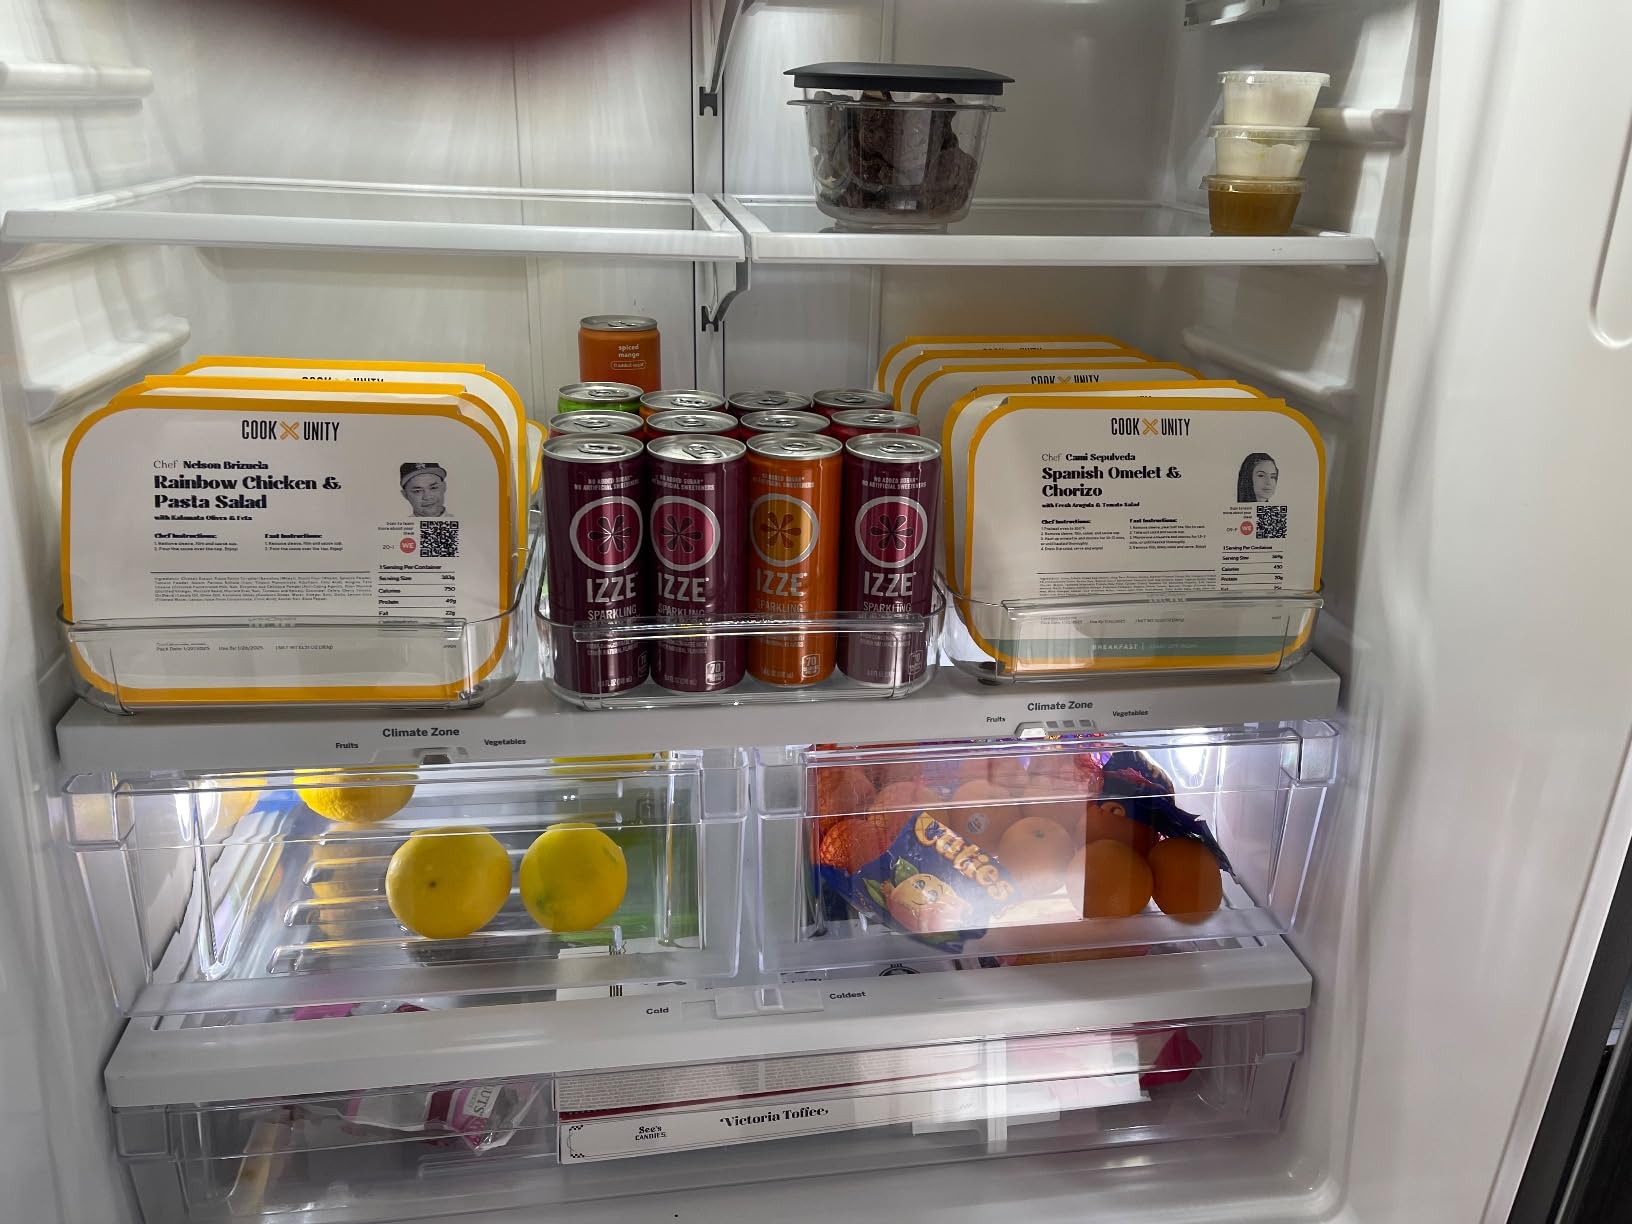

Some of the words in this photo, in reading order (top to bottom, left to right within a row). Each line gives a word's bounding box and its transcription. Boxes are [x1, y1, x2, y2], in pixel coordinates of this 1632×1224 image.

[618, 344, 639, 352] spiced
[242, 420, 277, 440] COOK
[304, 421, 340, 441] UNITY
[1111, 417, 1140, 436] COOK
[1161, 418, 1190, 437] UNITY
[1041, 453, 1062, 462] Chef
[1066, 453, 1088, 461] Cami
[1090, 453, 1136, 463] Sepulveda
[153, 459, 179, 469] Chef
[183, 460, 222, 470] Nelson
[224, 461, 269, 470] Brizuela
[1042, 465, 1104, 483] Spanish
[1108, 466, 1161, 479] Omelet
[1166, 466, 1182, 479] &
[154, 474, 238, 489] Rainbow
[242, 475, 317, 490] Chicken
[322, 476, 342, 490] &
[1042, 483, 1103, 497] Chorizo
[154, 494, 210, 508] Pasta
[215, 494, 267, 509] Salad
[587, 573, 638, 603] IZZE
[658, 572, 706, 602] IZZE
[757, 571, 805, 597] IZZE
[864, 571, 913, 597] IZZE
[588, 606, 637, 620] SPARKLING
[1027, 701, 1066, 712] Climate
[1068, 700, 1094, 710] Zone
[1112, 709, 1149, 718] Vegetables
[382, 728, 429, 738] Climate
[430, 727, 460, 737] Zone
[335, 742, 359, 750] Fruits
[484, 738, 527, 747] Vegetables
[829, 991, 867, 1000] Coldest
[645, 1006, 669, 1015] Cold
[639, 1125, 662, 1134] See's
[635, 1131, 667, 1141] CANDIES
